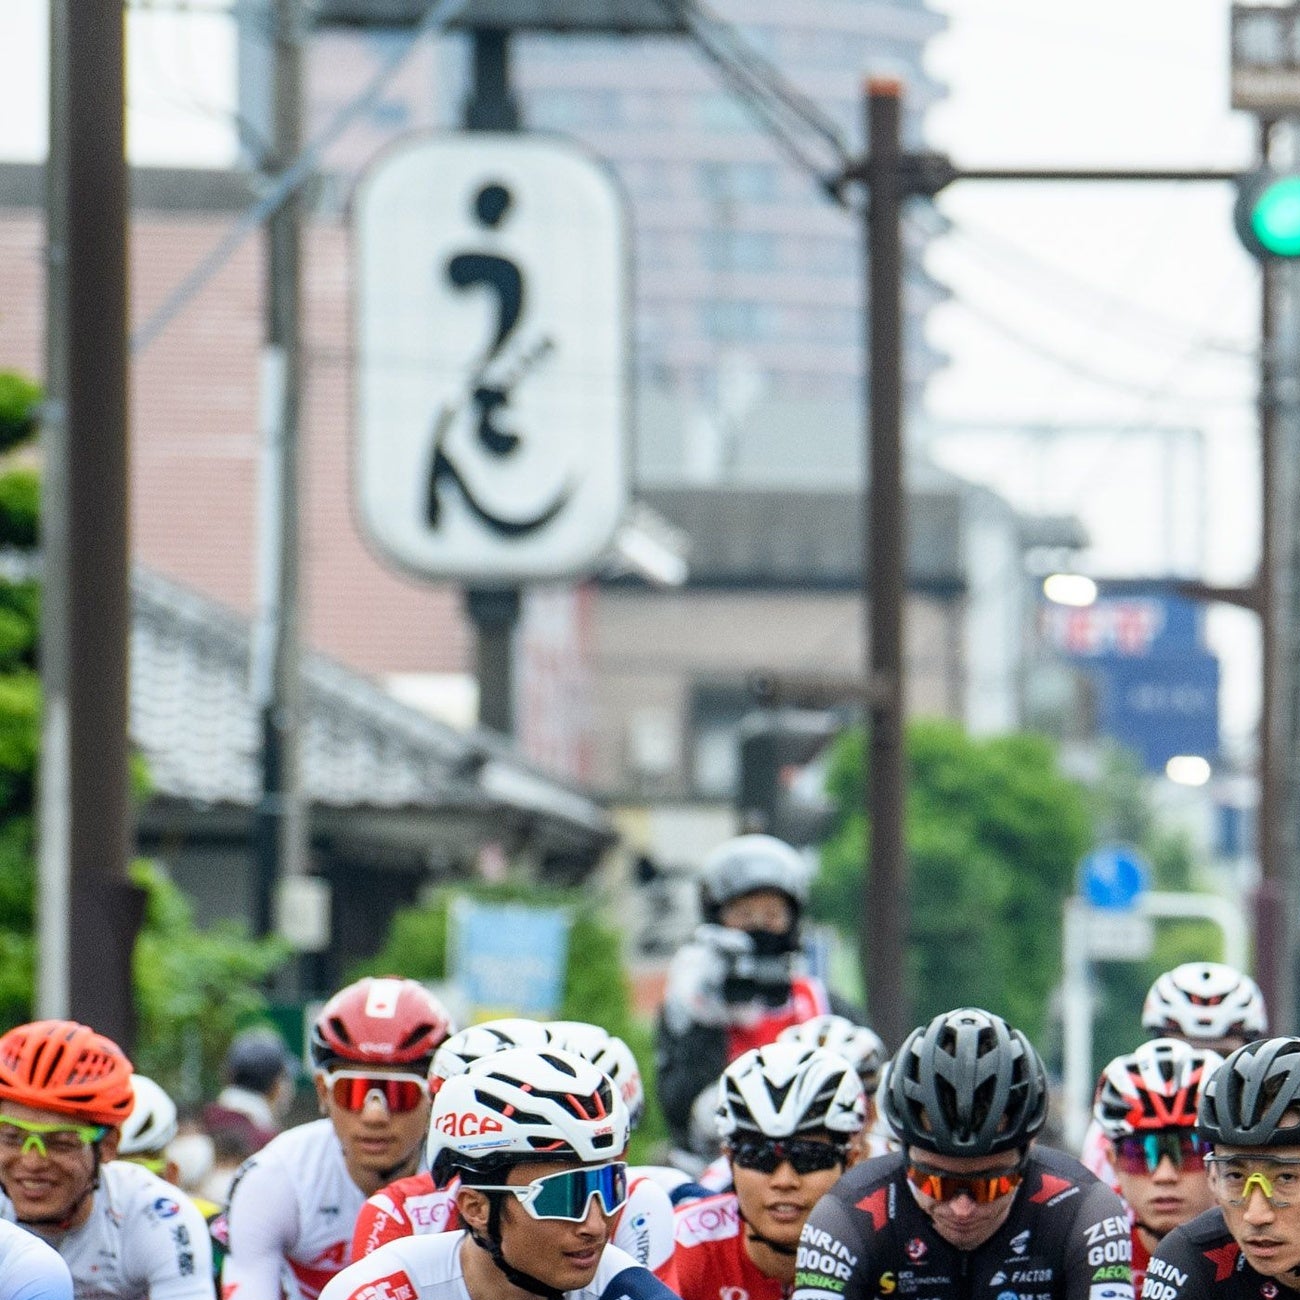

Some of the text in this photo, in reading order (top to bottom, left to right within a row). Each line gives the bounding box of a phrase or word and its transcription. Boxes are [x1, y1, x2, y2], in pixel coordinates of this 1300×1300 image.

[428, 185, 579, 536] うどん
[799, 1223, 858, 1267] ENRIN
[1011, 1268, 1053, 1283] FACTOR
